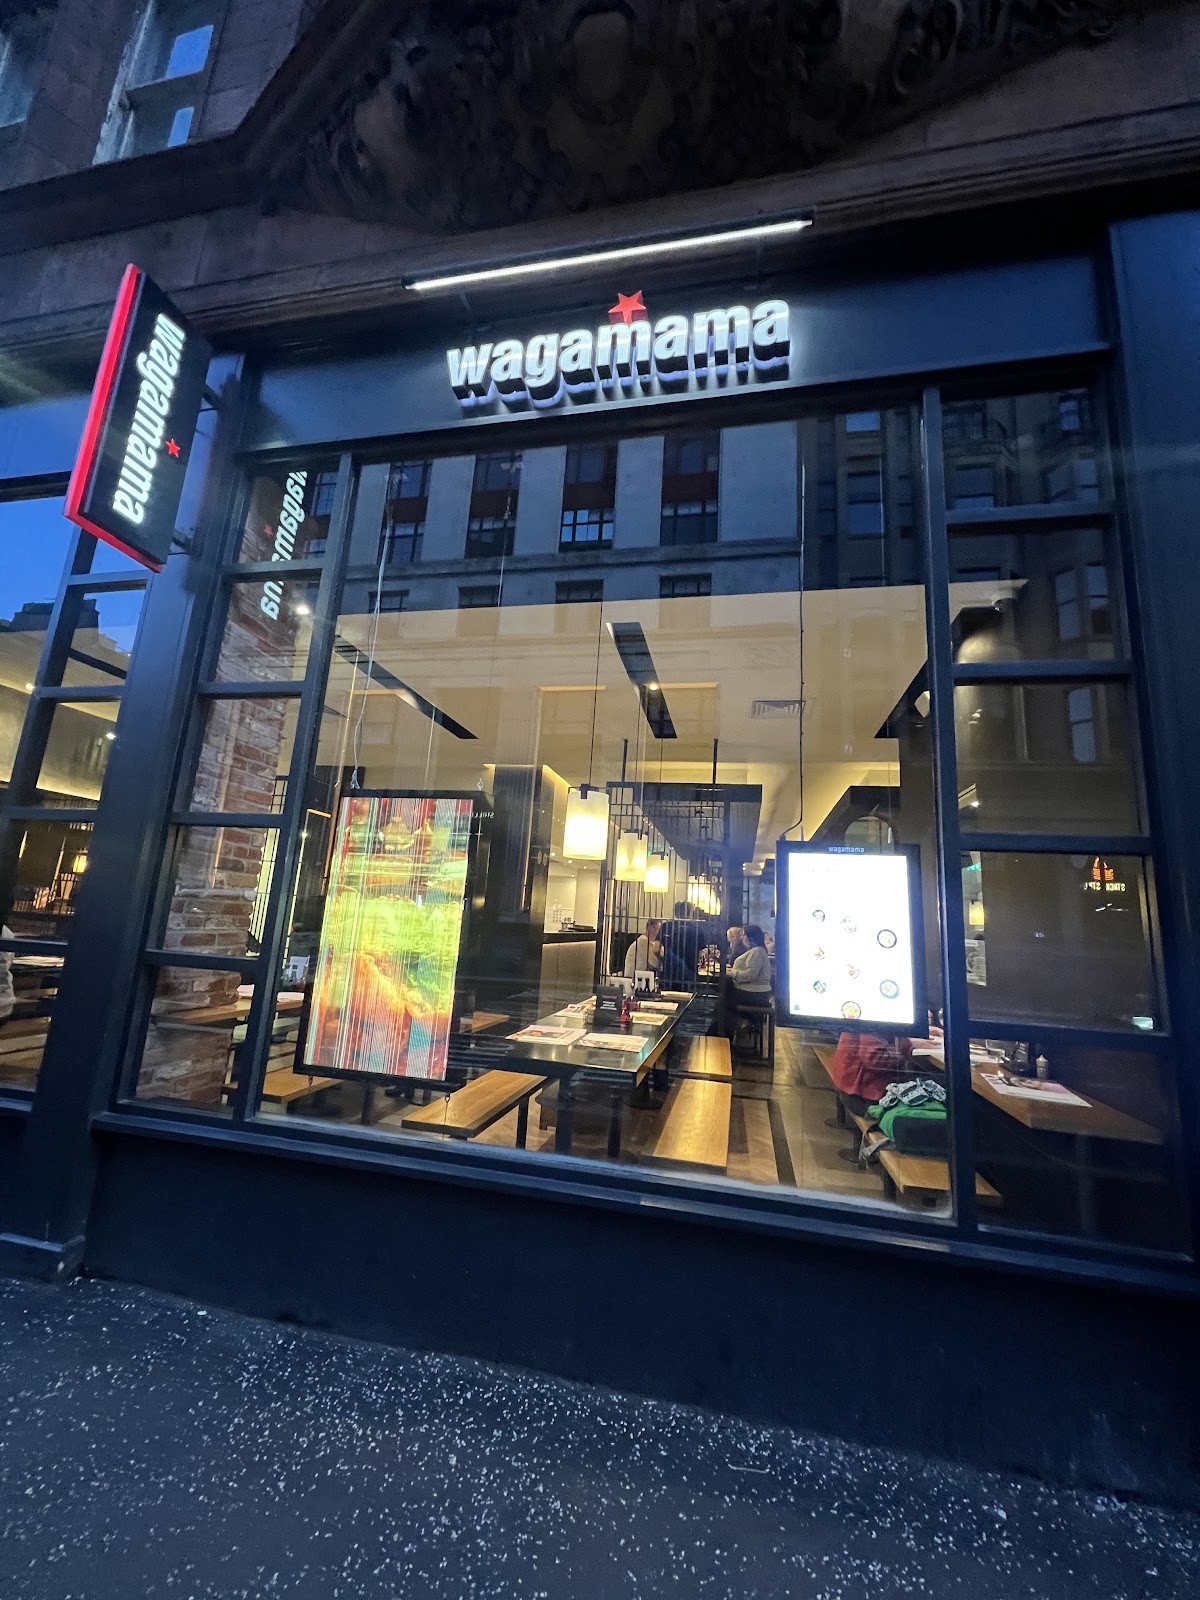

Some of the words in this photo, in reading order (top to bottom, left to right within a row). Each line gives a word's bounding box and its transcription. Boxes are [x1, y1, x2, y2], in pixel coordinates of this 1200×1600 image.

[446, 299, 790, 392] wagamama
[112, 313, 187, 525] wagamama
[828, 845, 865, 854] wagamama
